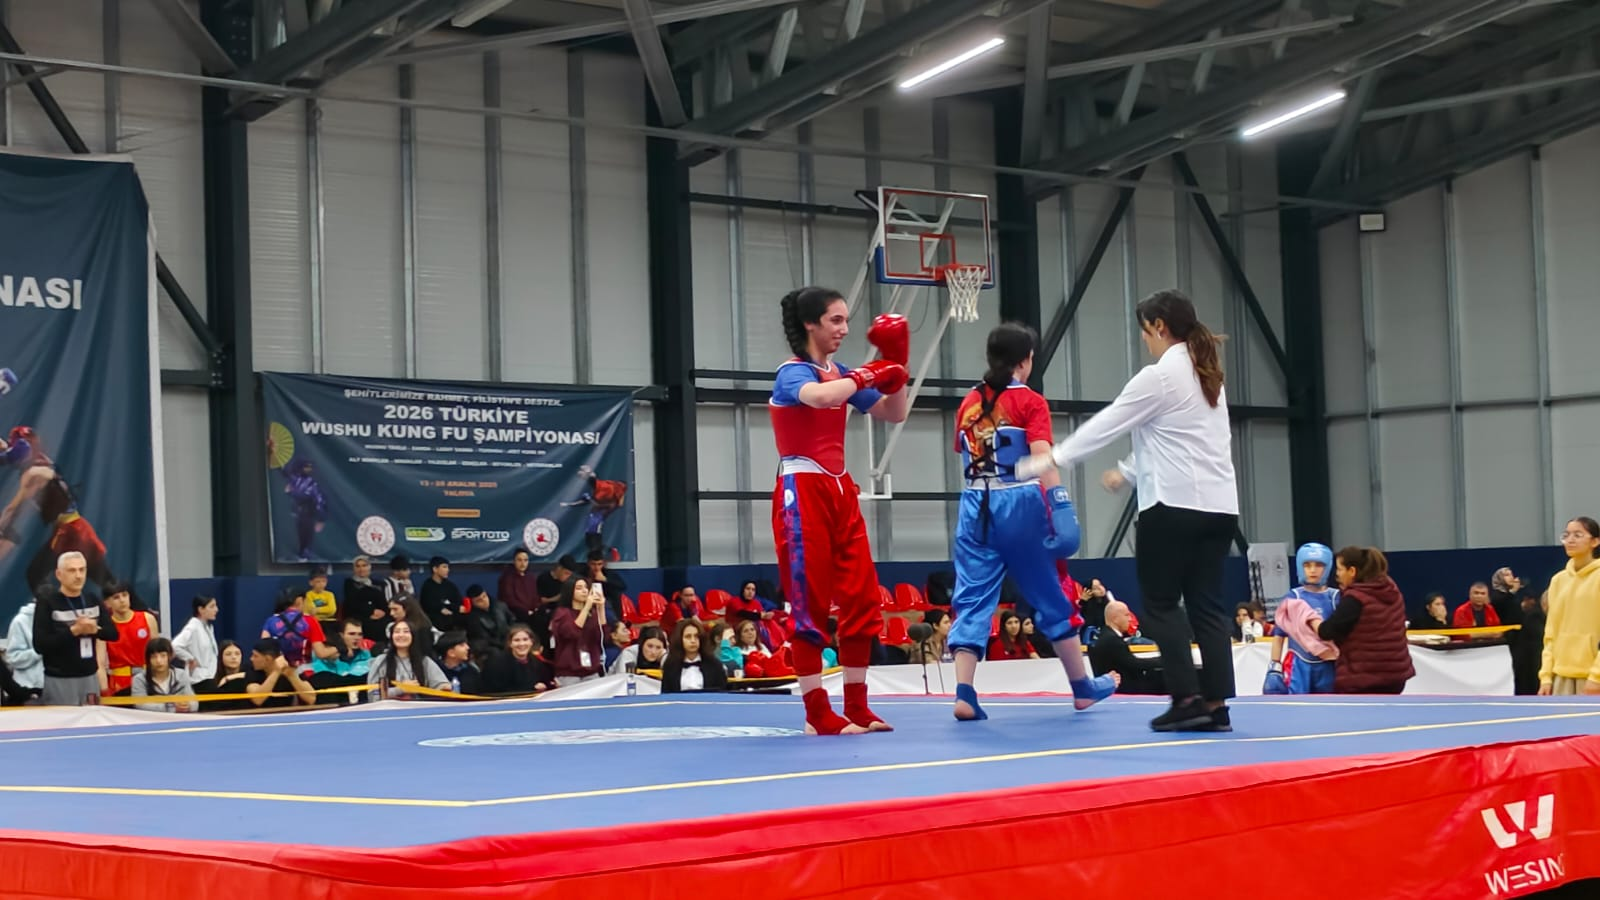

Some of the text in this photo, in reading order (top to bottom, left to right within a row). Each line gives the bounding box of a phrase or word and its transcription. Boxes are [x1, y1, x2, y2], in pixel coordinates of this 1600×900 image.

[384, 404, 529, 424] 2026 TÜRKİYE
[302, 422, 600, 444] WUSHU KUNG FU ŞAMPİYONASI
